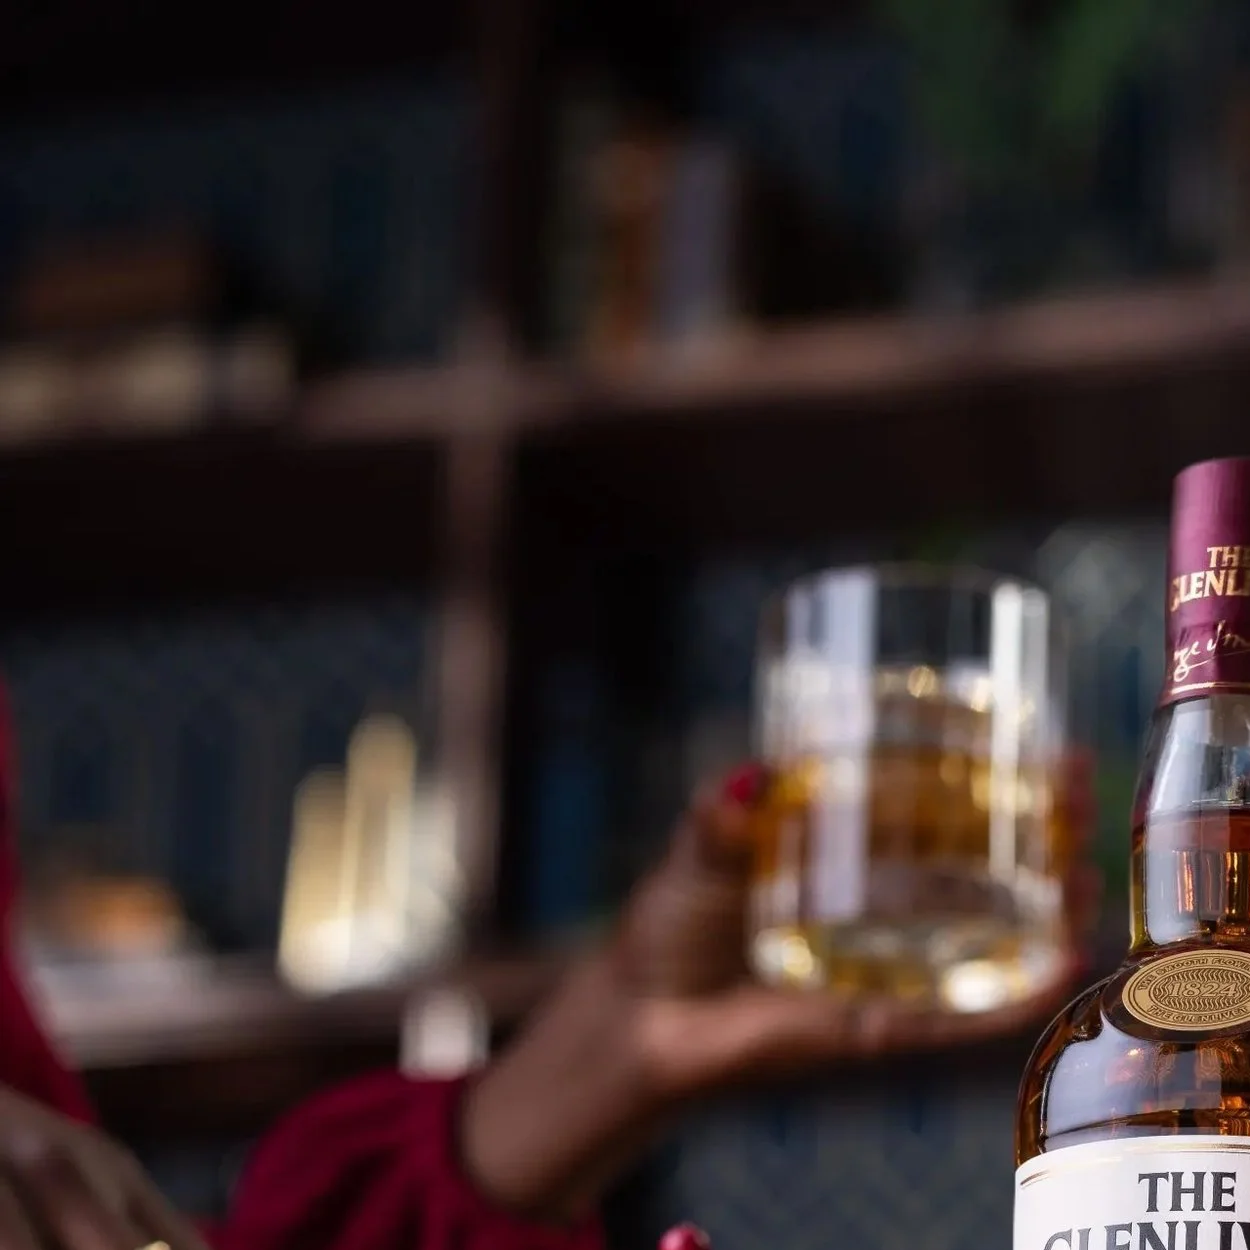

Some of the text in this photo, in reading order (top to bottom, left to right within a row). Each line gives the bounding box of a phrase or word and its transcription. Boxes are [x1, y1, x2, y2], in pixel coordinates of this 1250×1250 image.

[1138, 974, 1156, 991] THE
[1156, 957, 1208, 976] SMOOTH
[1169, 981, 1238, 998] 1824
[1138, 1171, 1237, 1213] THE
